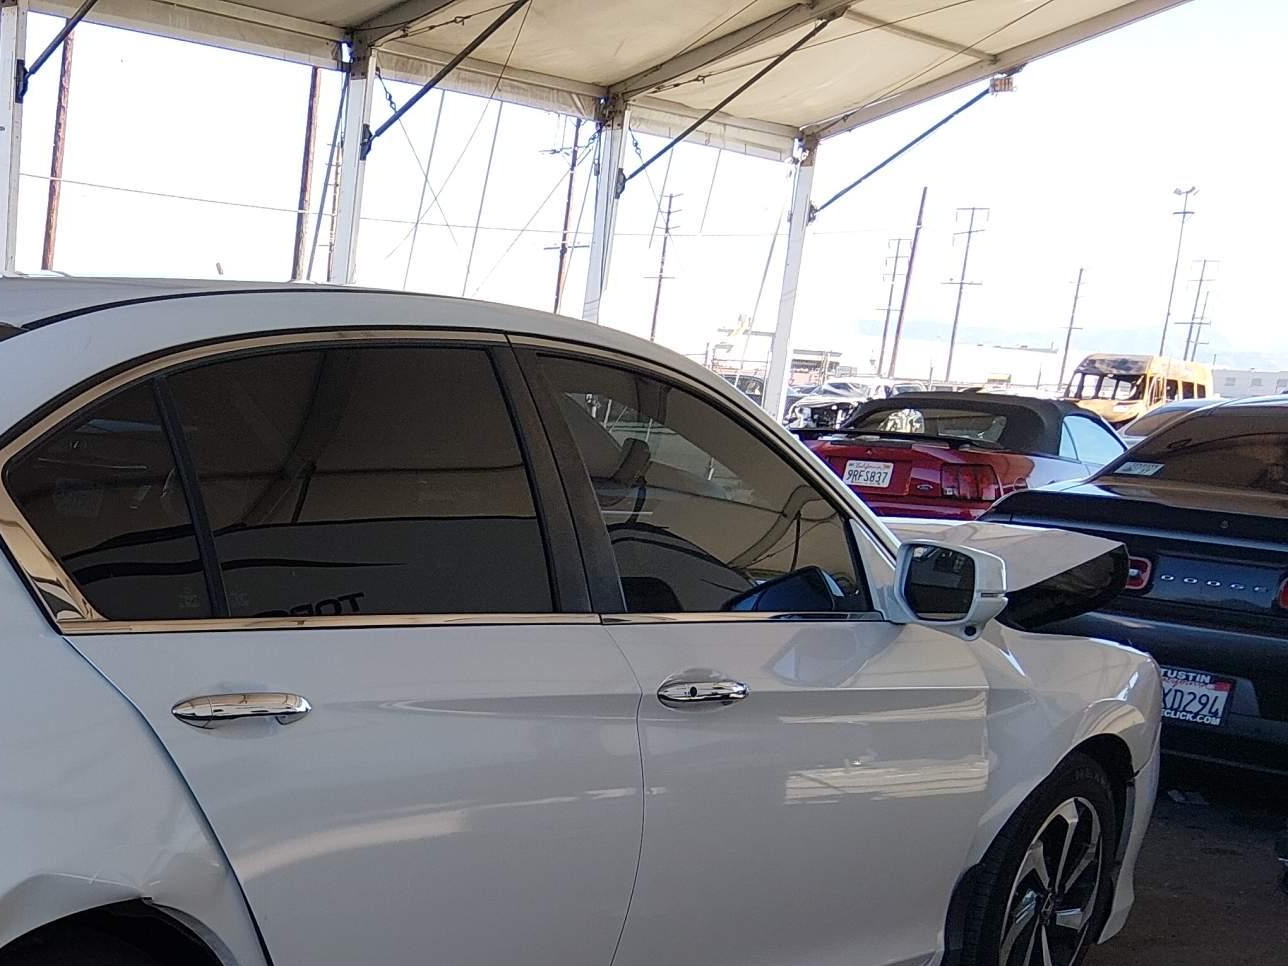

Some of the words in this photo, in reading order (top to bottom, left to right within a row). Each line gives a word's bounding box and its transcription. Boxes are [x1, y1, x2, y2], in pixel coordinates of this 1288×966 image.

[846, 469, 889, 484] 9RFS837
[1160, 667, 1211, 684] TUSTIN
[1161, 686, 1220, 717] XD294
